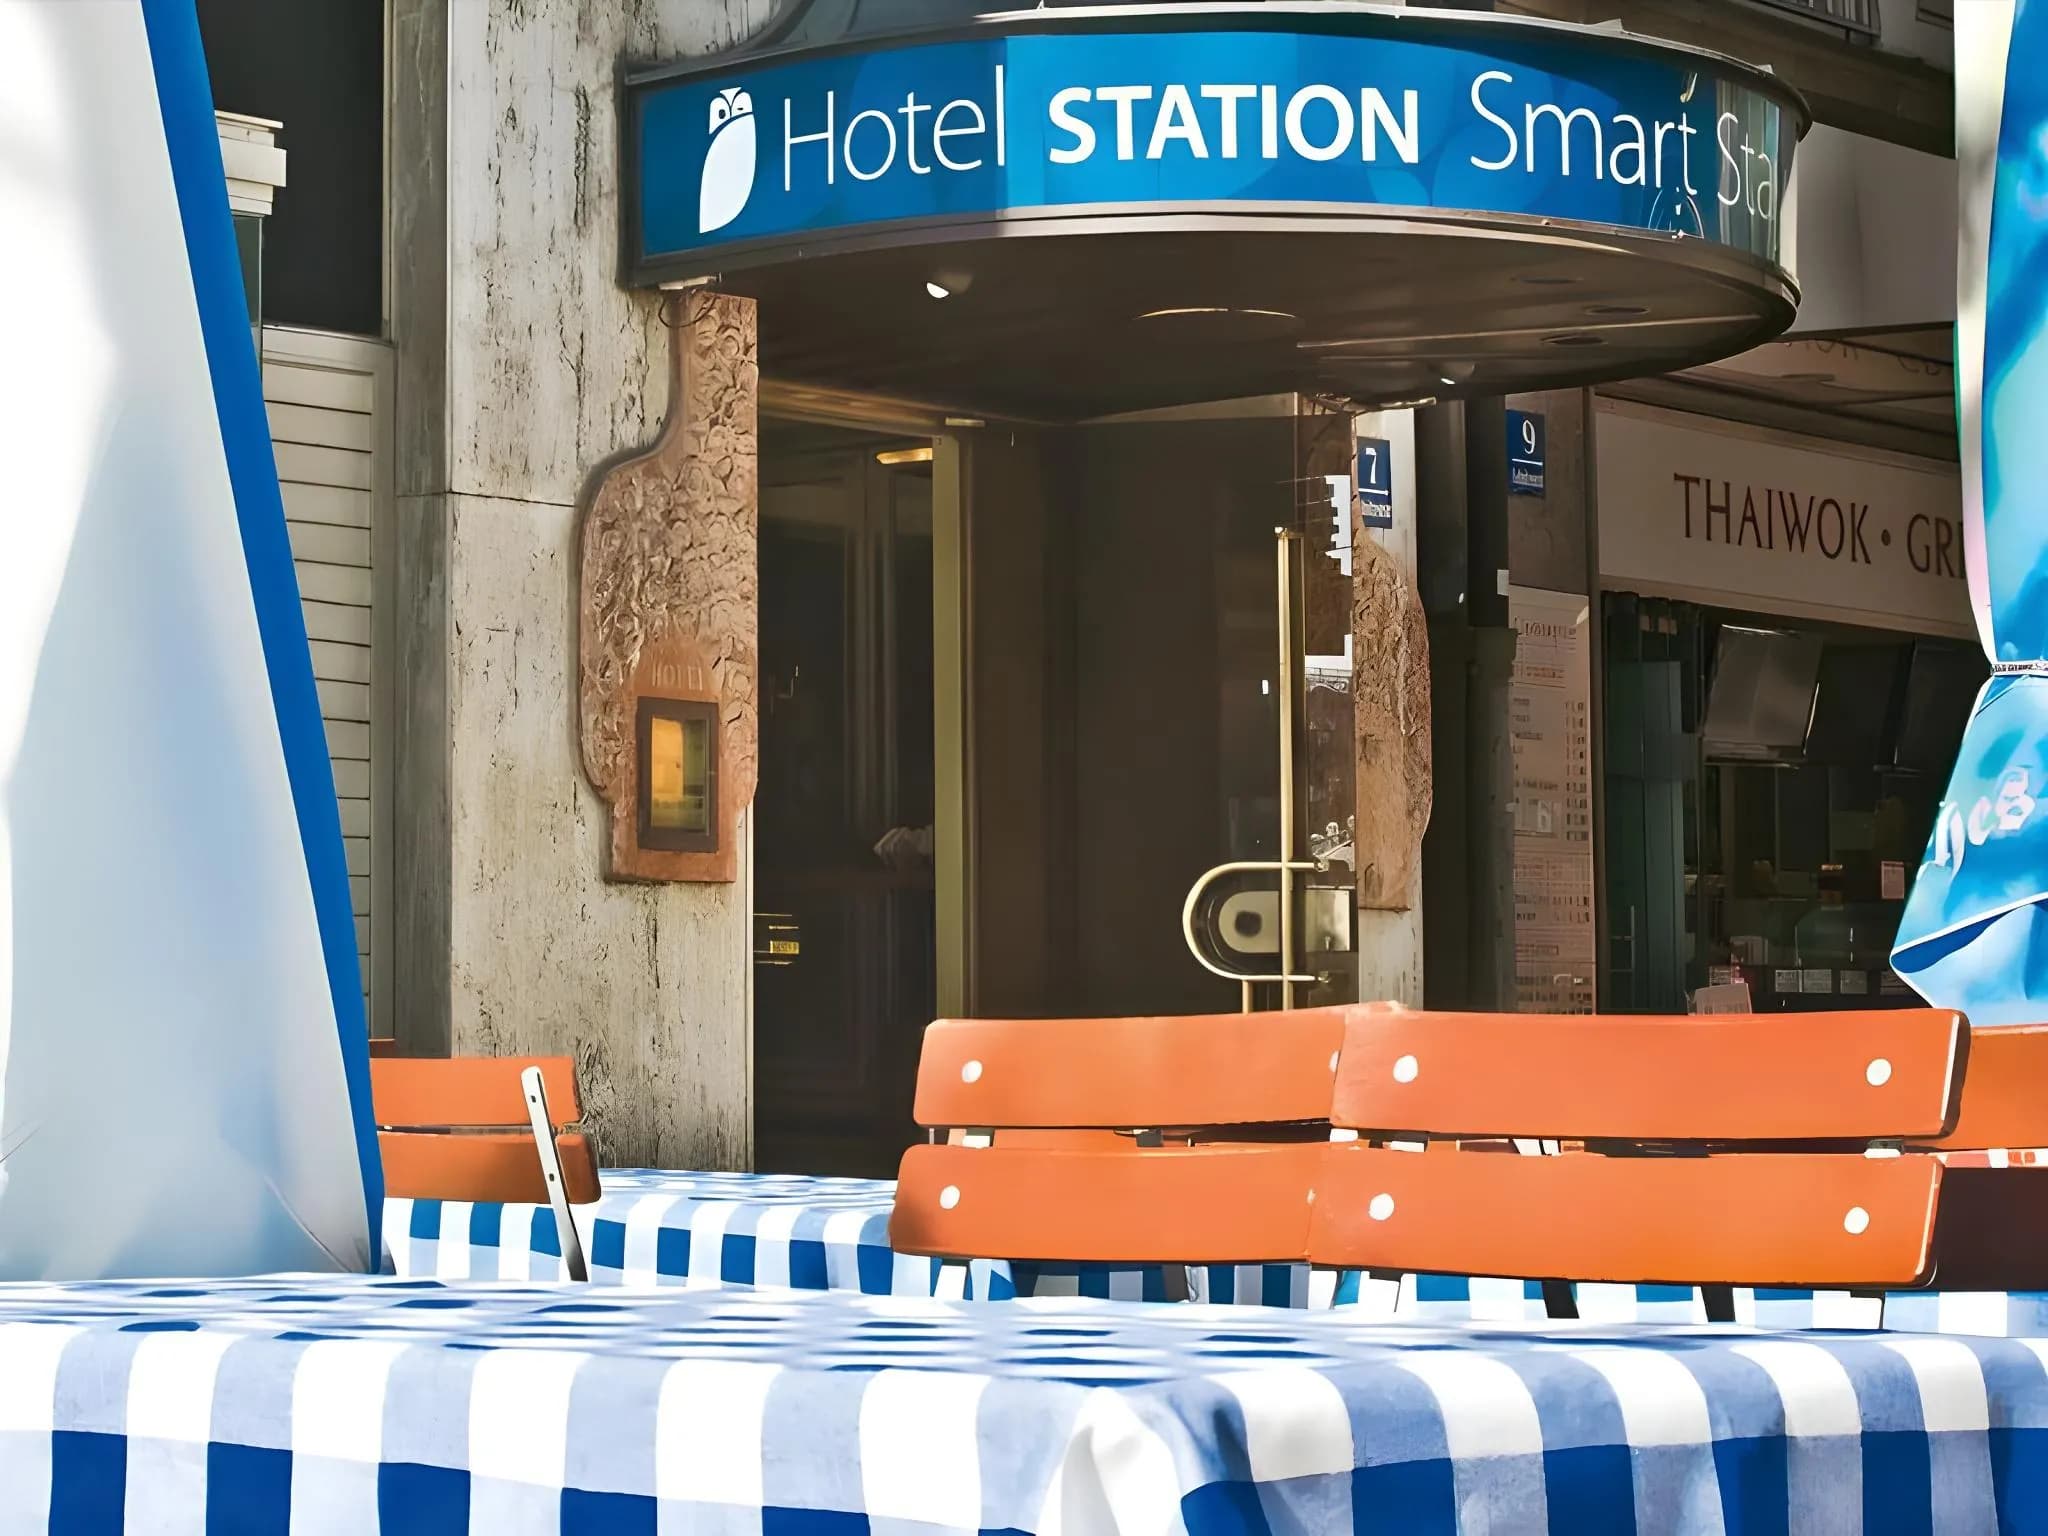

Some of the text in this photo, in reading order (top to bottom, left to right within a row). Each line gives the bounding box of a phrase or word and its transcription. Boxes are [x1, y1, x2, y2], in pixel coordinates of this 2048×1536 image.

[784, 66, 1005, 192] Hotel
[1048, 84, 1419, 164] STATION
[1470, 71, 1698, 196] Smart
[1364, 447, 1378, 485] 7
[1522, 419, 1537, 455] 9
[1673, 471, 1872, 565] THAIWOK
